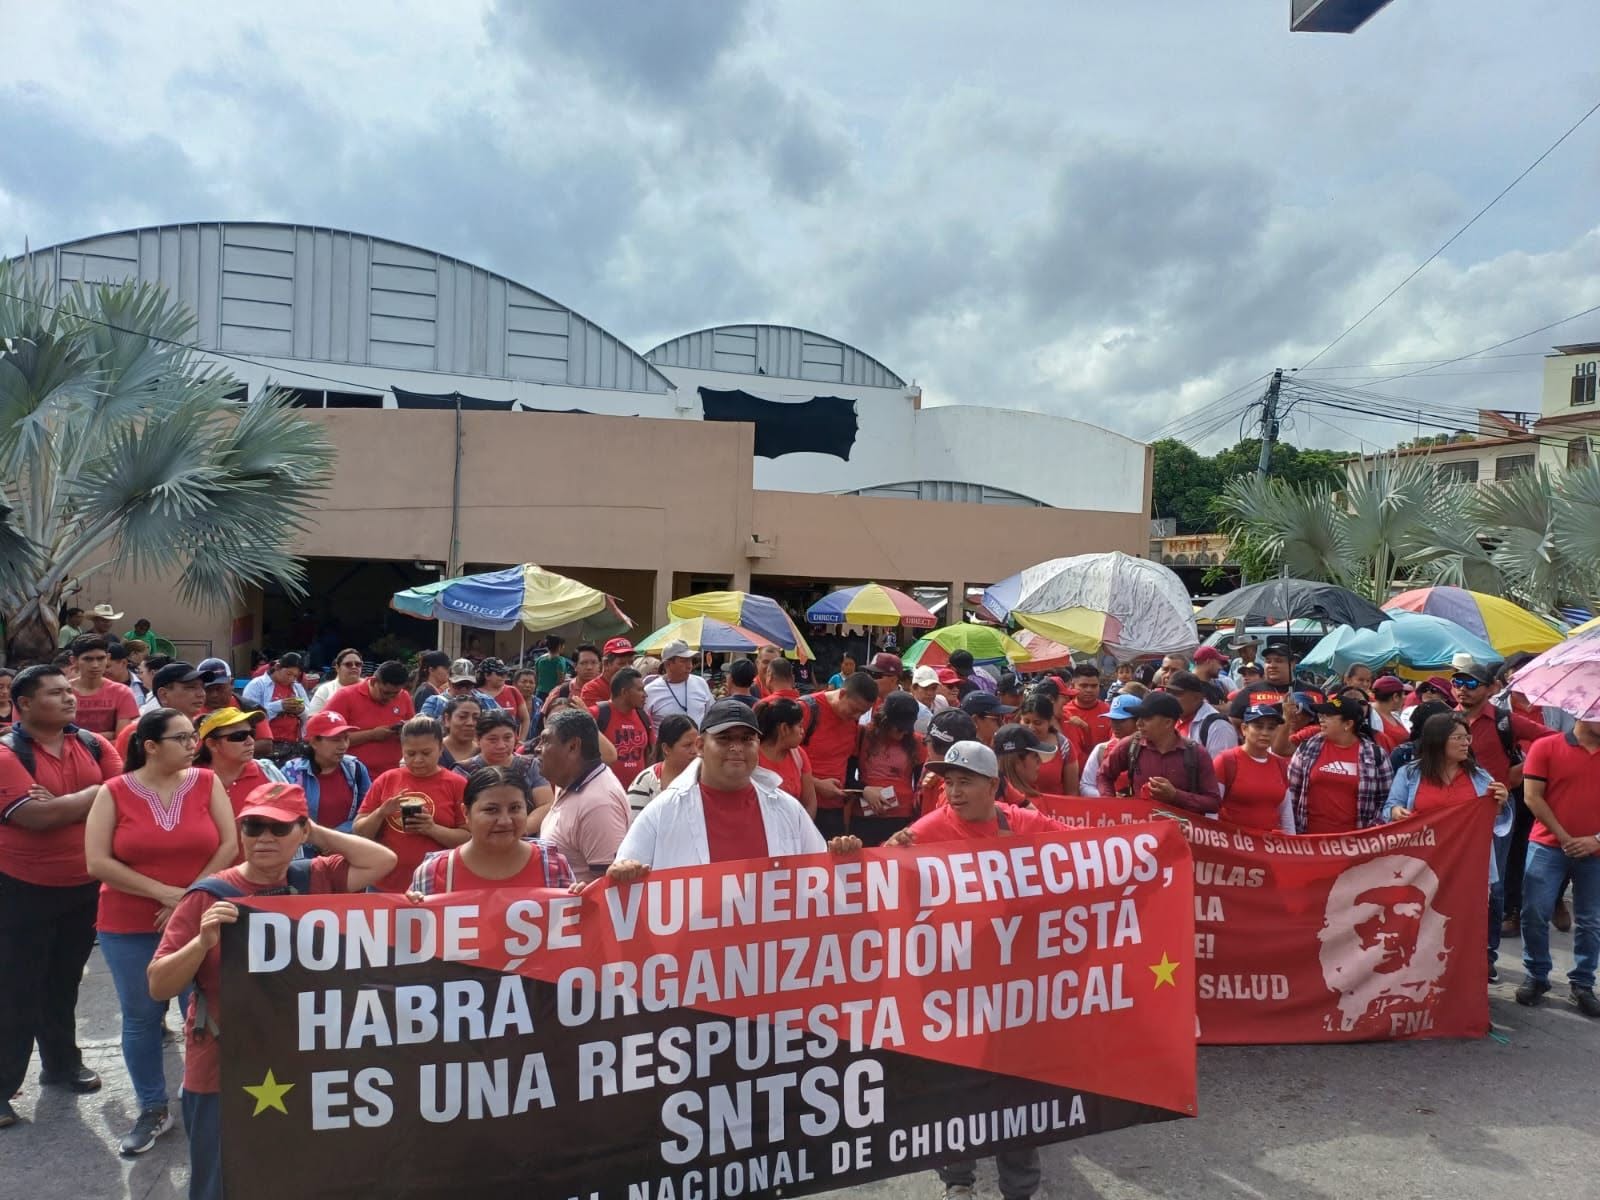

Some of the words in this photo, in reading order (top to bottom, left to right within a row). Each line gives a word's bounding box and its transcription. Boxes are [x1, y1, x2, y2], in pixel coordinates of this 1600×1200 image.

[1575, 360, 1600, 377] HO
[813, 613, 839, 622] DIRECT
[905, 616, 931, 626] DIRECT
[1233, 828, 1255, 852] de
[1263, 832, 1315, 856] Salud
[1192, 861, 1266, 888] ULAS
[248, 904, 480, 974] DONDE
[504, 896, 583, 957] SE
[604, 859, 899, 943] VULNEREN
[915, 833, 1174, 908] DERECHOS,
[298, 957, 535, 1052] HABRÁ
[556, 909, 973, 1028] ORGANIZACIÓN
[990, 915, 1025, 967] Y
[1037, 884, 1143, 960] ESTÁ
[1198, 973, 1290, 1001] SALUD
[1389, 1009, 1434, 1037] FNL
[311, 1066, 394, 1131] ES
[419, 1051, 557, 1124] UNA
[578, 996, 905, 1102] RESPUESTA
[922, 962, 1134, 1043] SINDICAL
[660, 1058, 885, 1165] SNTSG
[628, 1148, 815, 1200] NACIONAL
[831, 1140, 873, 1176] DE
[889, 1094, 1087, 1163] CHIQUIMULA
